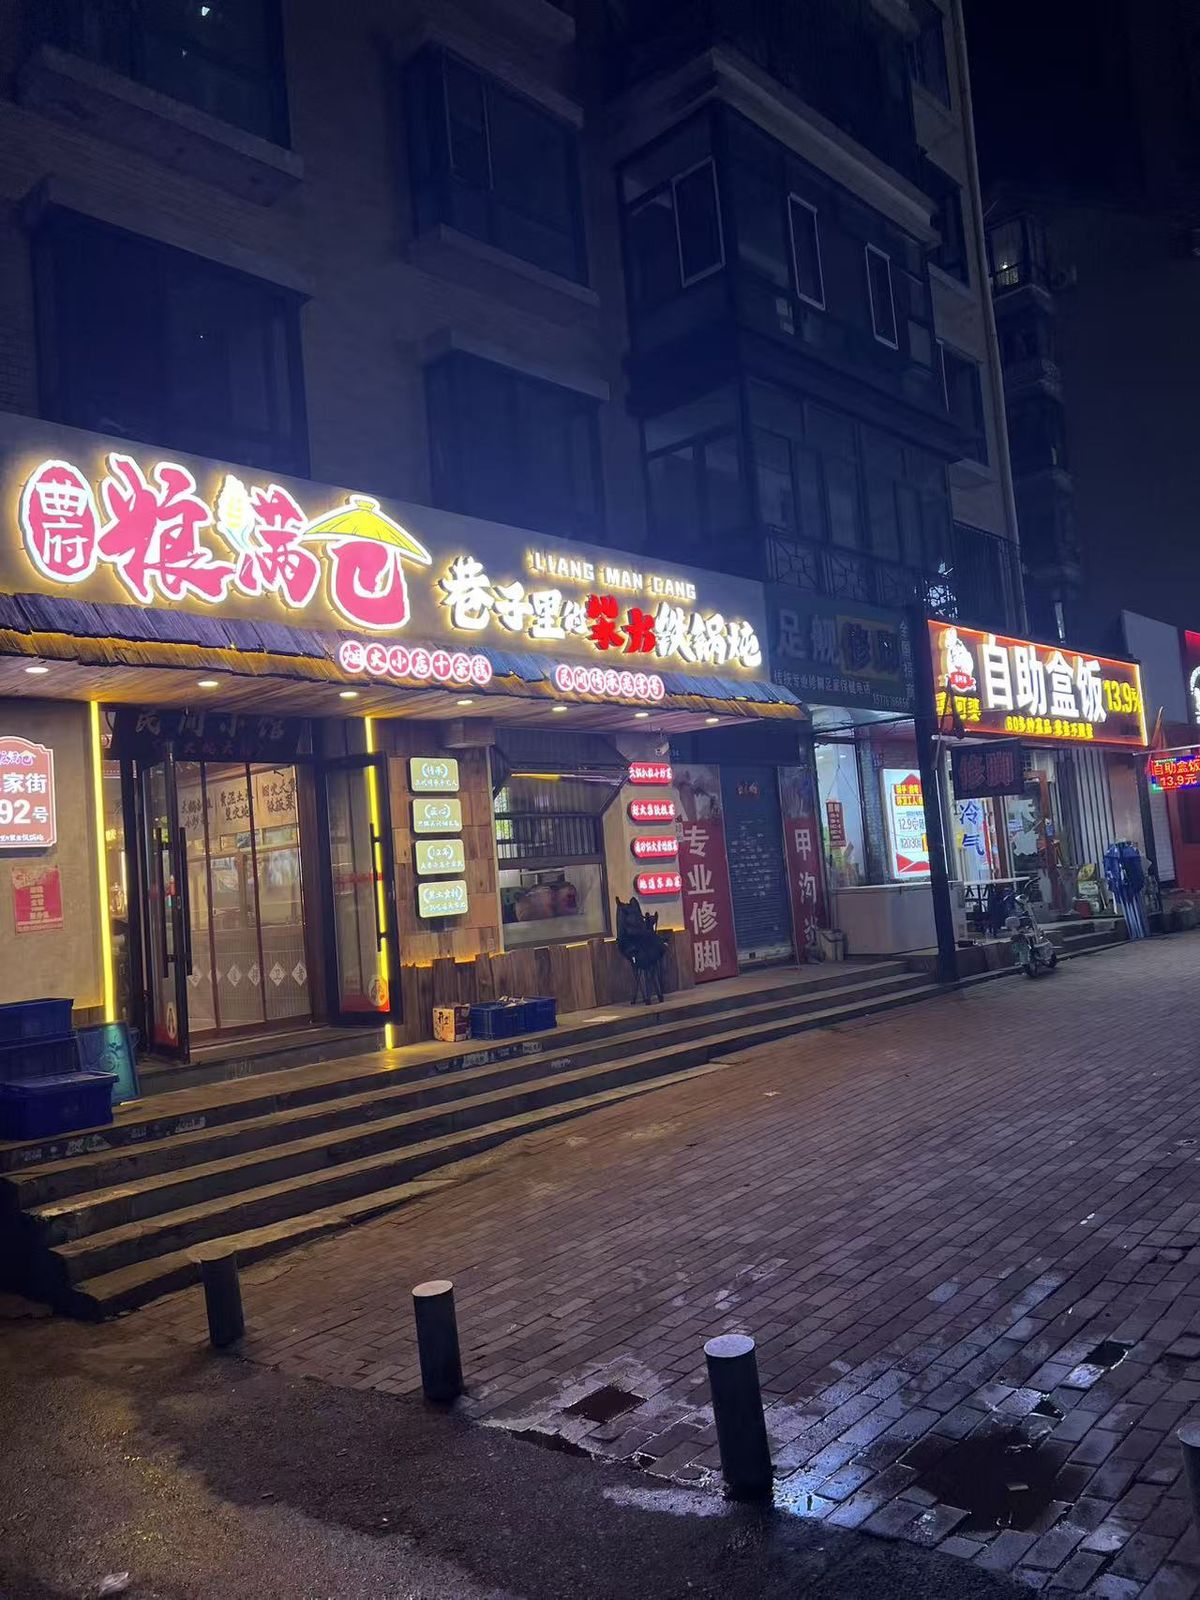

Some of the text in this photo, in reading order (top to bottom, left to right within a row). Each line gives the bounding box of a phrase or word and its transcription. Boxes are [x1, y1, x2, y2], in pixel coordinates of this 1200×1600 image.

[533, 552, 696, 600] LIANG MAN CANG
[978, 634, 1107, 722] 自助盒饭
[1103, 680, 1141, 713] 13.9元
[0, 772, 47, 794] 家街
[1160, 774, 1197, 786] 13.9元
[960, 801, 984, 855] 冷气
[682, 825, 721, 972] 专业修脚
